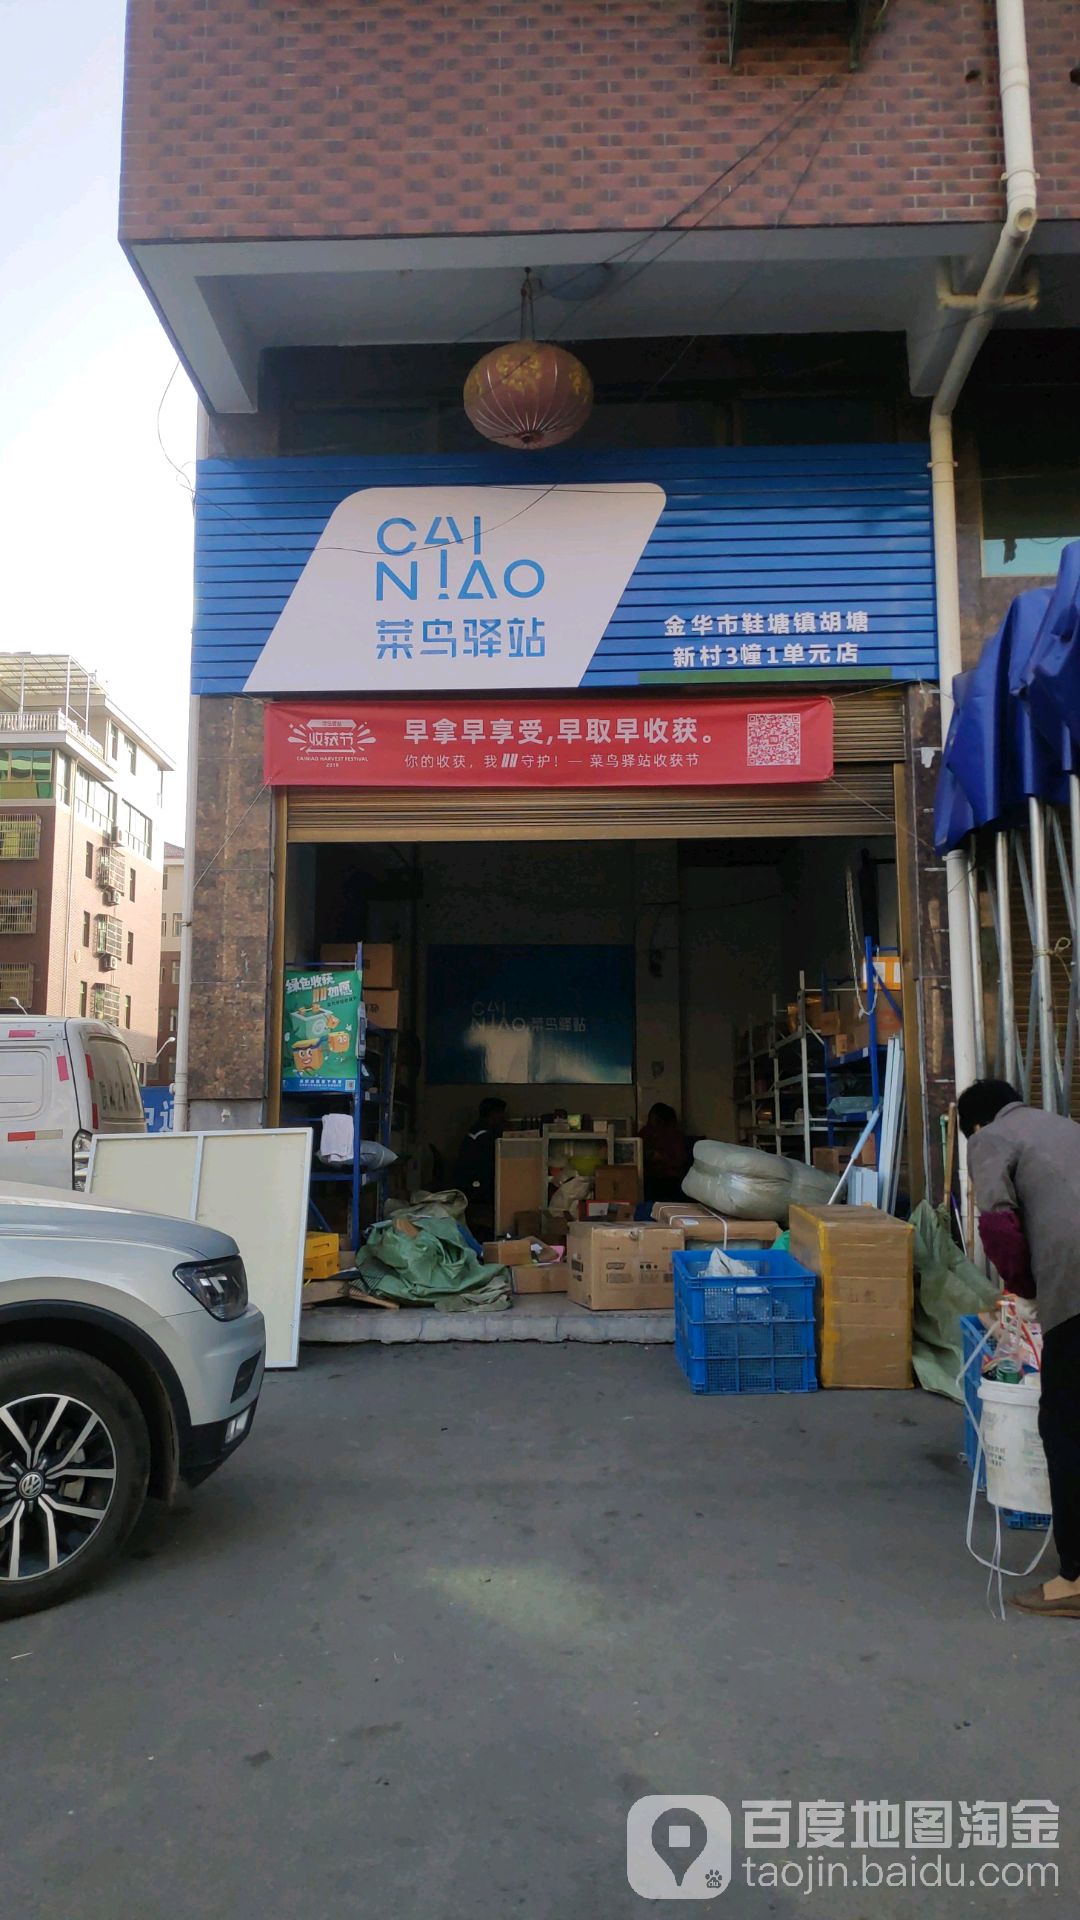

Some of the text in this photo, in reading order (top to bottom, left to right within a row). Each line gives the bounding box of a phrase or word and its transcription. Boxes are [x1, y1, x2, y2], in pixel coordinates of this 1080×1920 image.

[377, 516, 481, 556] CAI
[376, 549, 545, 601] NIAO
[376, 617, 545, 659] 菜鸟驿站
[664, 611, 869, 636] 金华市鞋塘镇胡塘
[589, 753, 700, 769] 菜鸟驿站收获节
